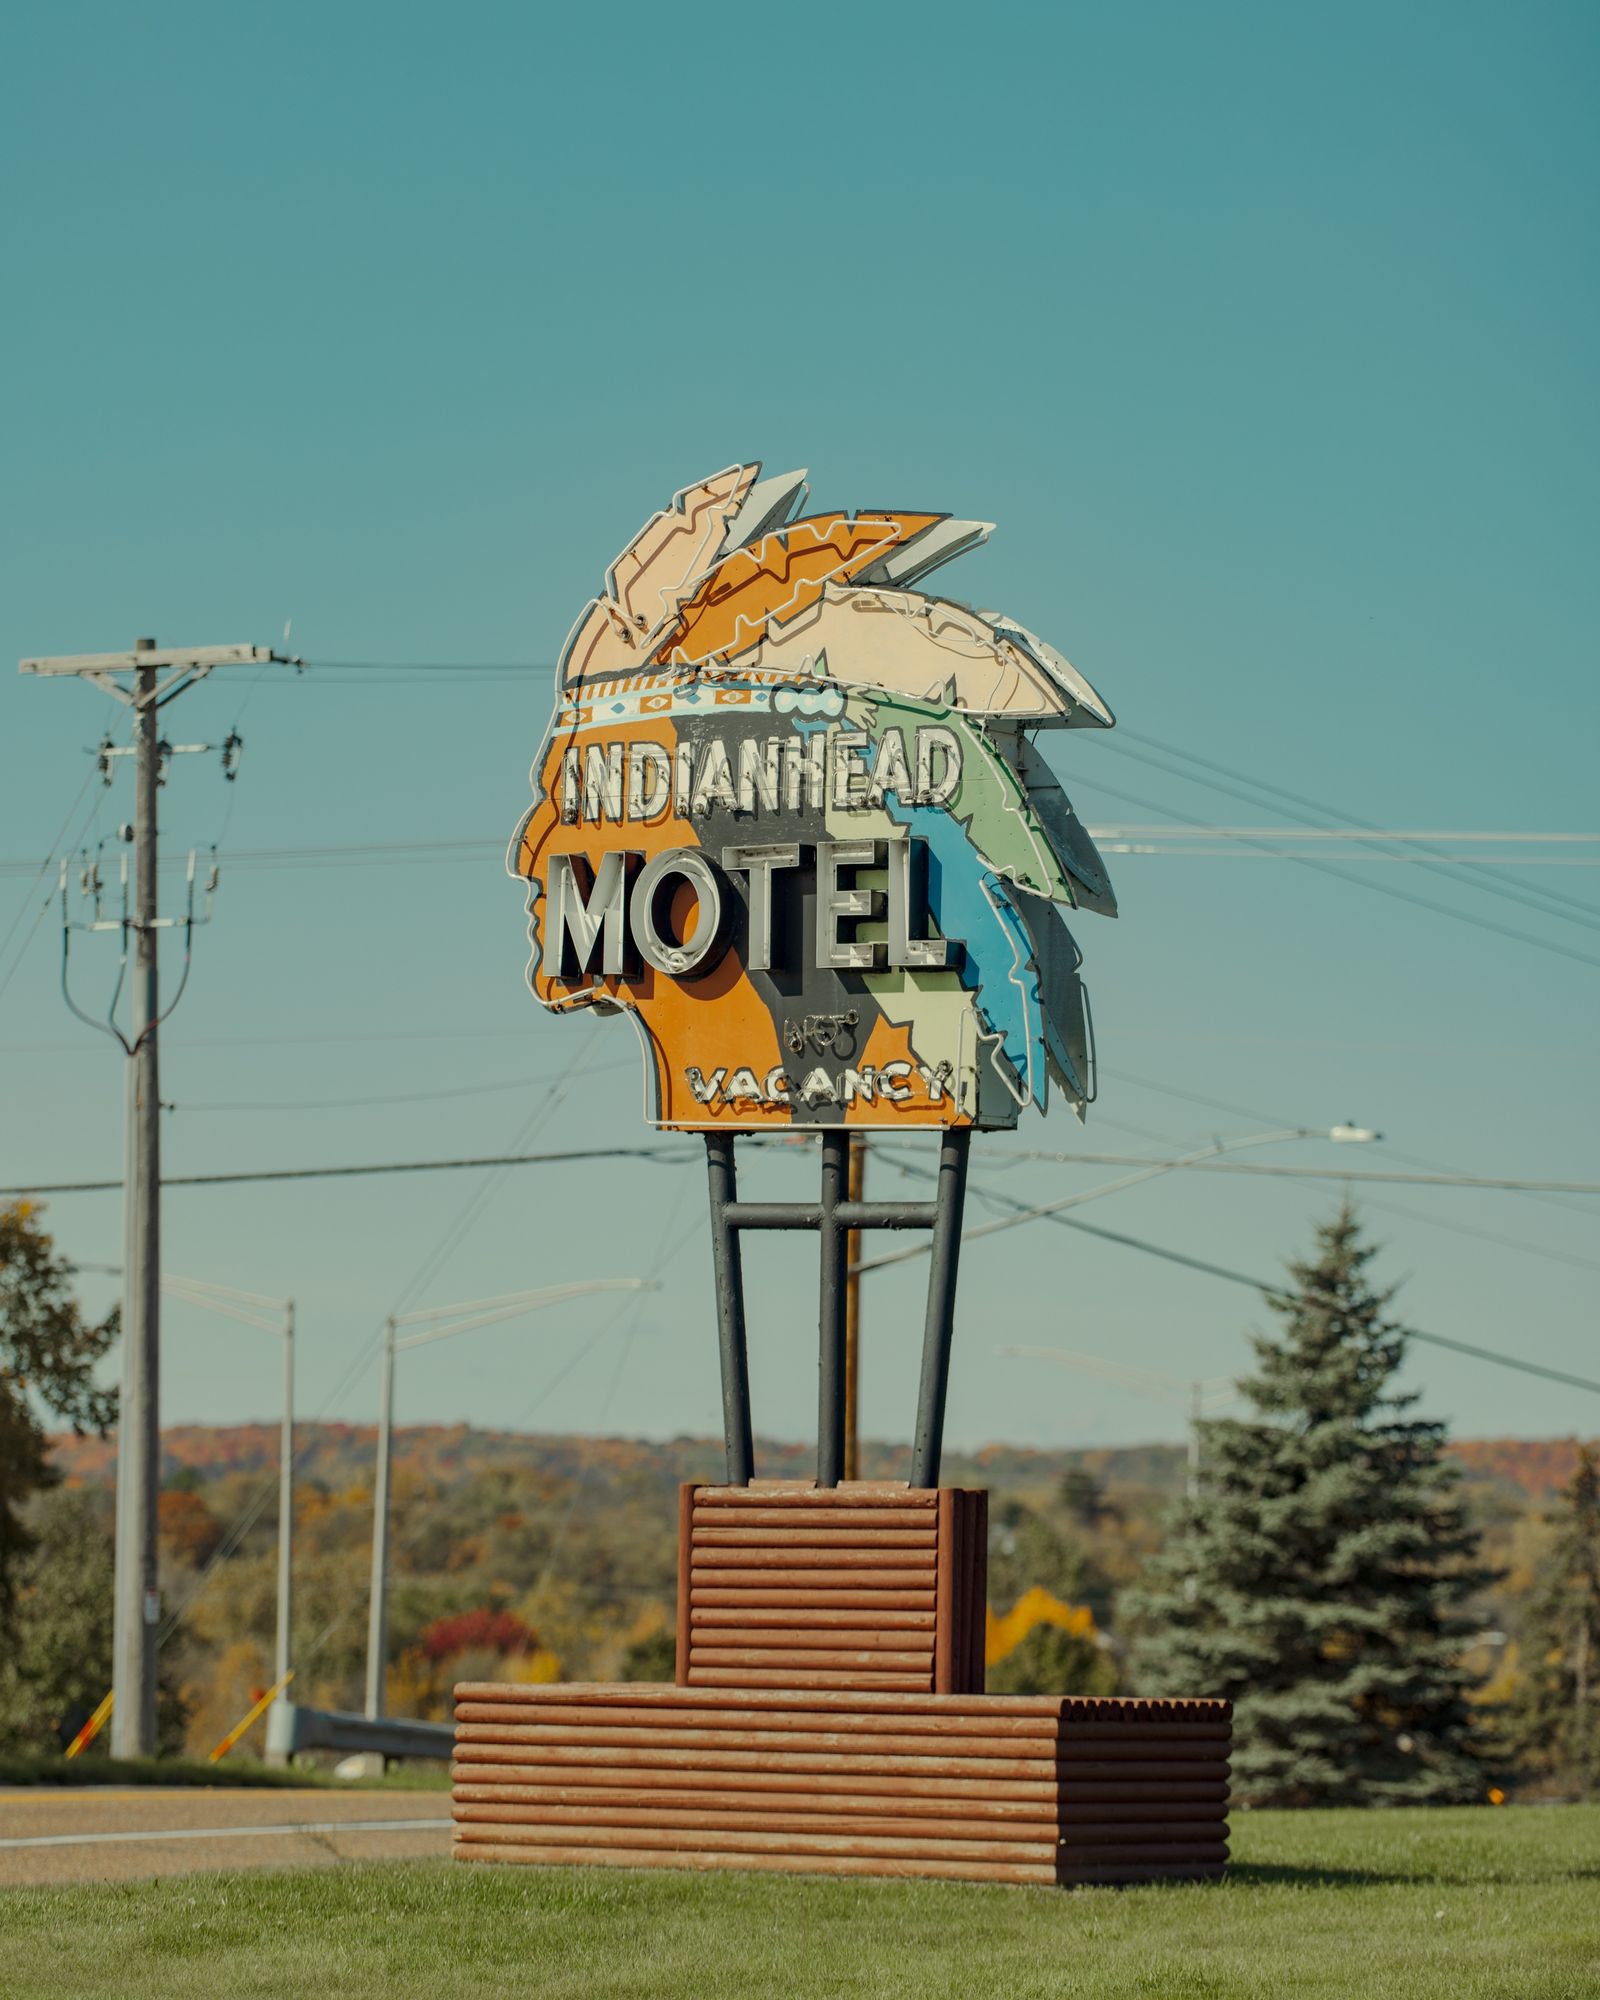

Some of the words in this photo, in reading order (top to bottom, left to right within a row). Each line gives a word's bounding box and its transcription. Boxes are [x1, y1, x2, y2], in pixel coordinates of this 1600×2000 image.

[561, 727, 962, 822] INDIANHEAD
[543, 838, 956, 978] MOTEL
[685, 1060, 953, 1105] VACANCY
